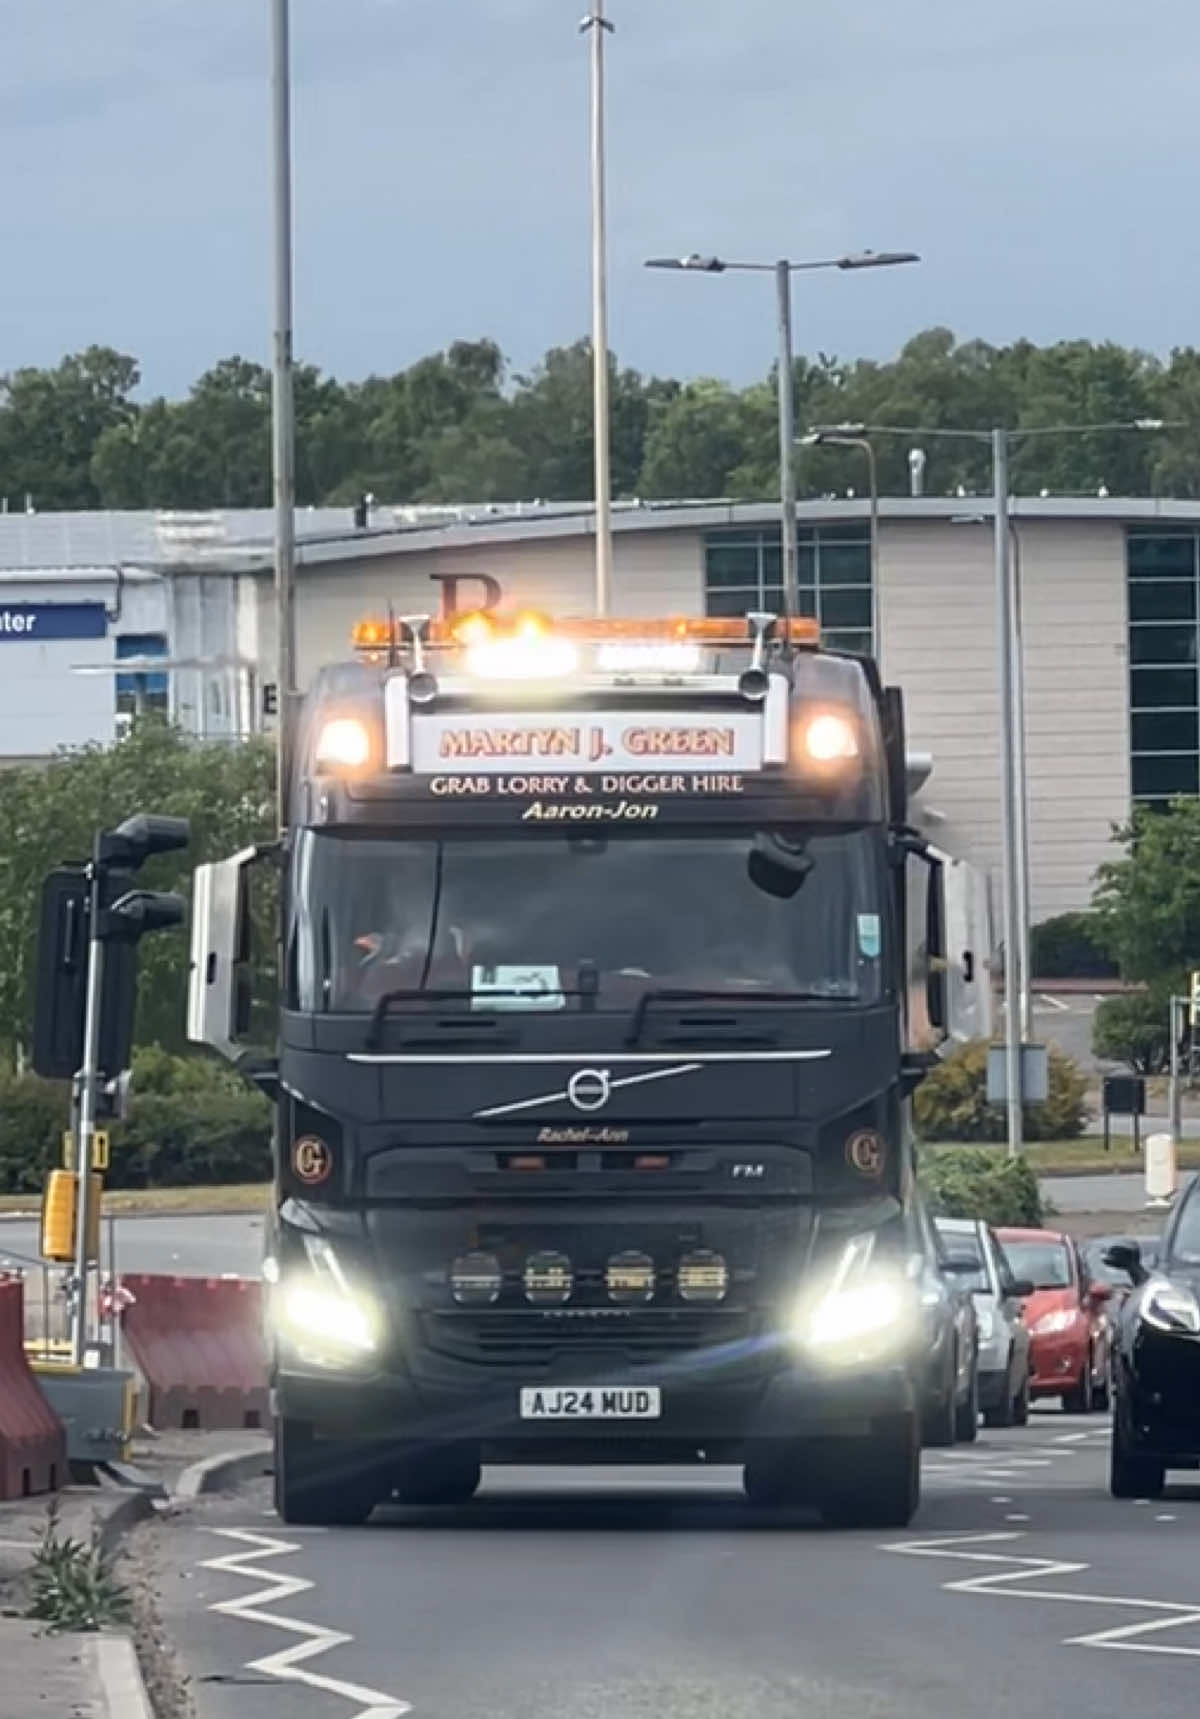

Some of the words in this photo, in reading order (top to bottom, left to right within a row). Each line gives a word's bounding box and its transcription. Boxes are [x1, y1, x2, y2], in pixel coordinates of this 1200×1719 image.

[0, 611, 37, 632] ter
[439, 727, 580, 757] MARTYN
[589, 727, 613, 761] J.
[622, 727, 734, 756] GREEN
[430, 776, 490, 794] GRAB
[497, 776, 569, 794] LORRY
[574, 776, 593, 794] &
[602, 775, 686, 793] DIGGER
[692, 775, 744, 793] HIRE
[521, 801, 659, 820] Aaron-Jon
[733, 1164, 764, 1177] FM
[532, 1391, 594, 1414] AJ24
[602, 1390, 649, 1413] MUD
